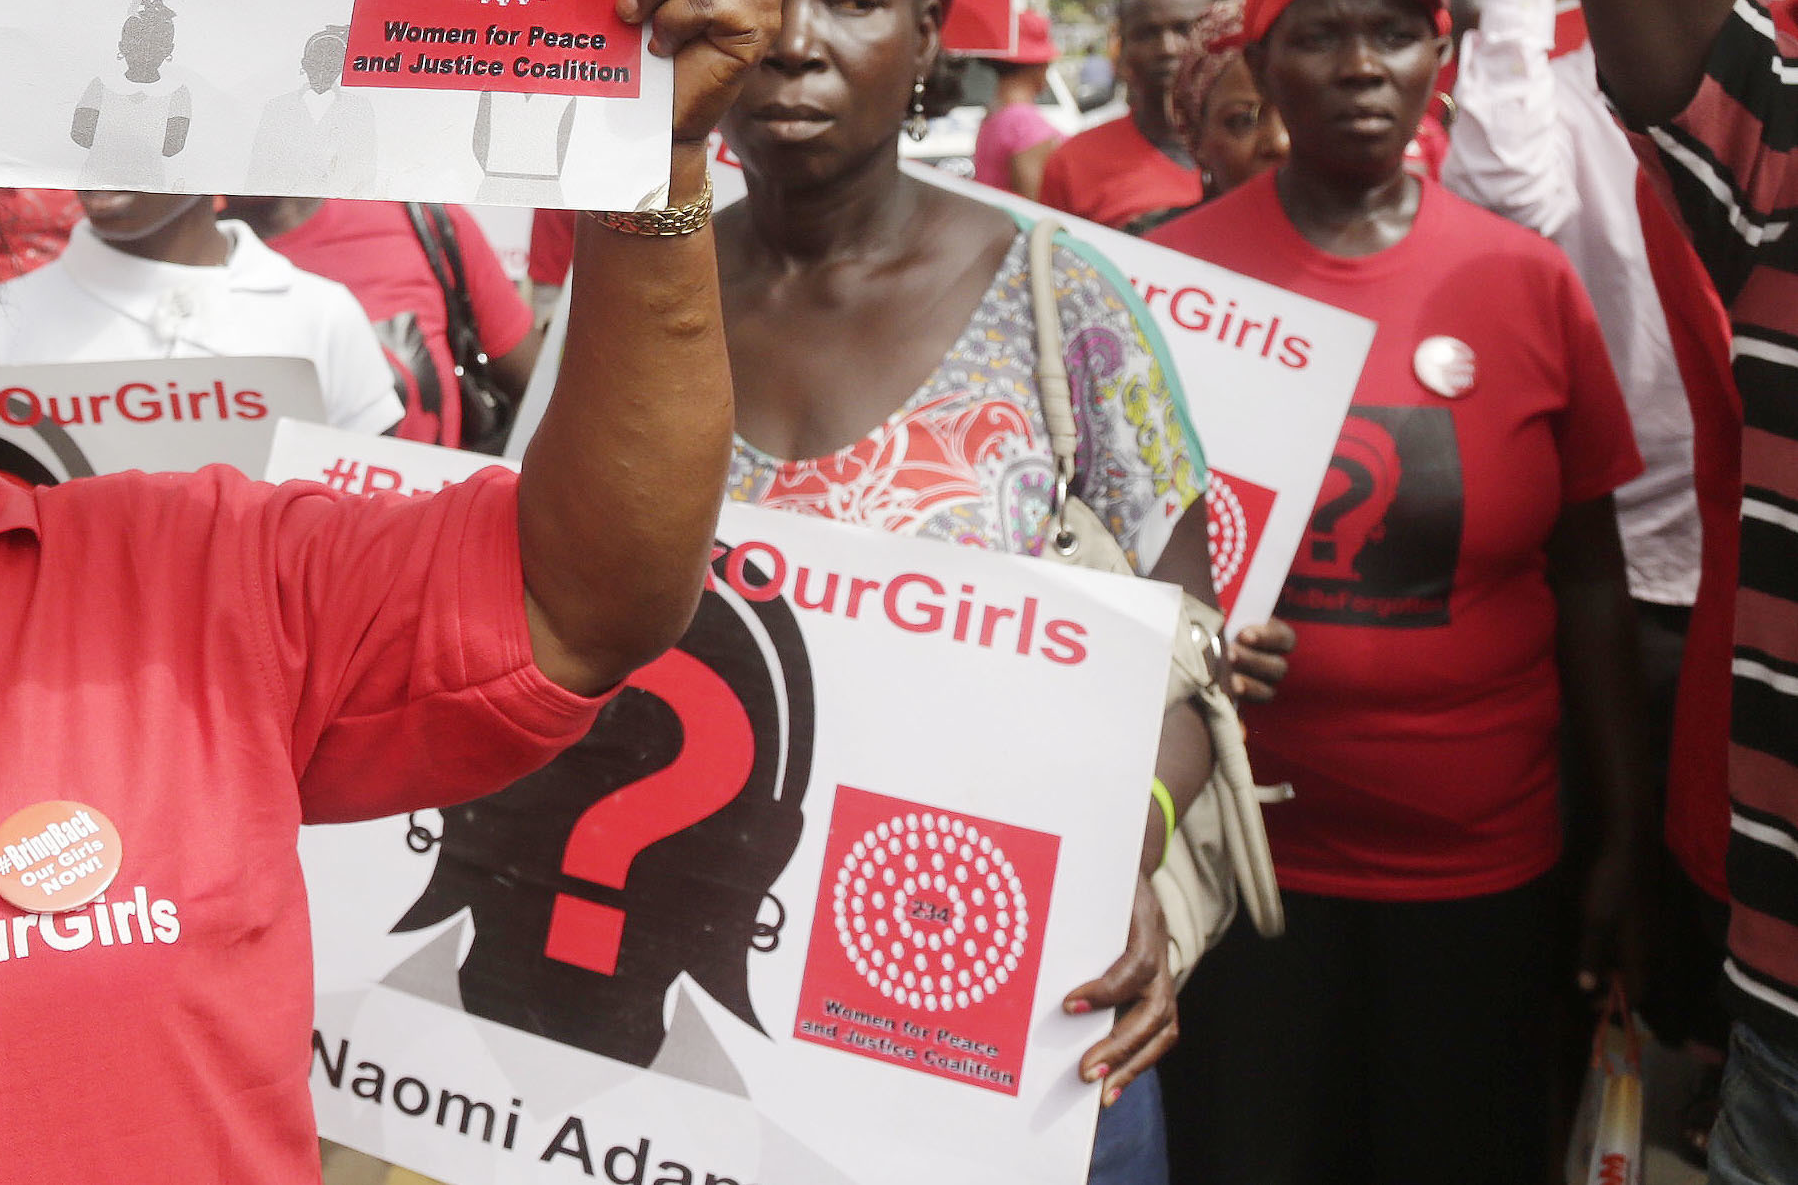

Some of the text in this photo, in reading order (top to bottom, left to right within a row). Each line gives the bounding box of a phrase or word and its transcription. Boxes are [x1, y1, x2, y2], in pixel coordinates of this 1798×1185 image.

[384, 21, 607, 50] Women for Peace
[353, 52, 630, 83] and Justice Coalition
[20, 840, 104, 887] Our Girls
[40, 855, 104, 896] NOW!
[910, 900, 950, 923] 234
[825, 999, 999, 1059] Women for Peace
[801, 1020, 1014, 1086] and Justice Coalition
[312, 1028, 523, 1150] Naomi
